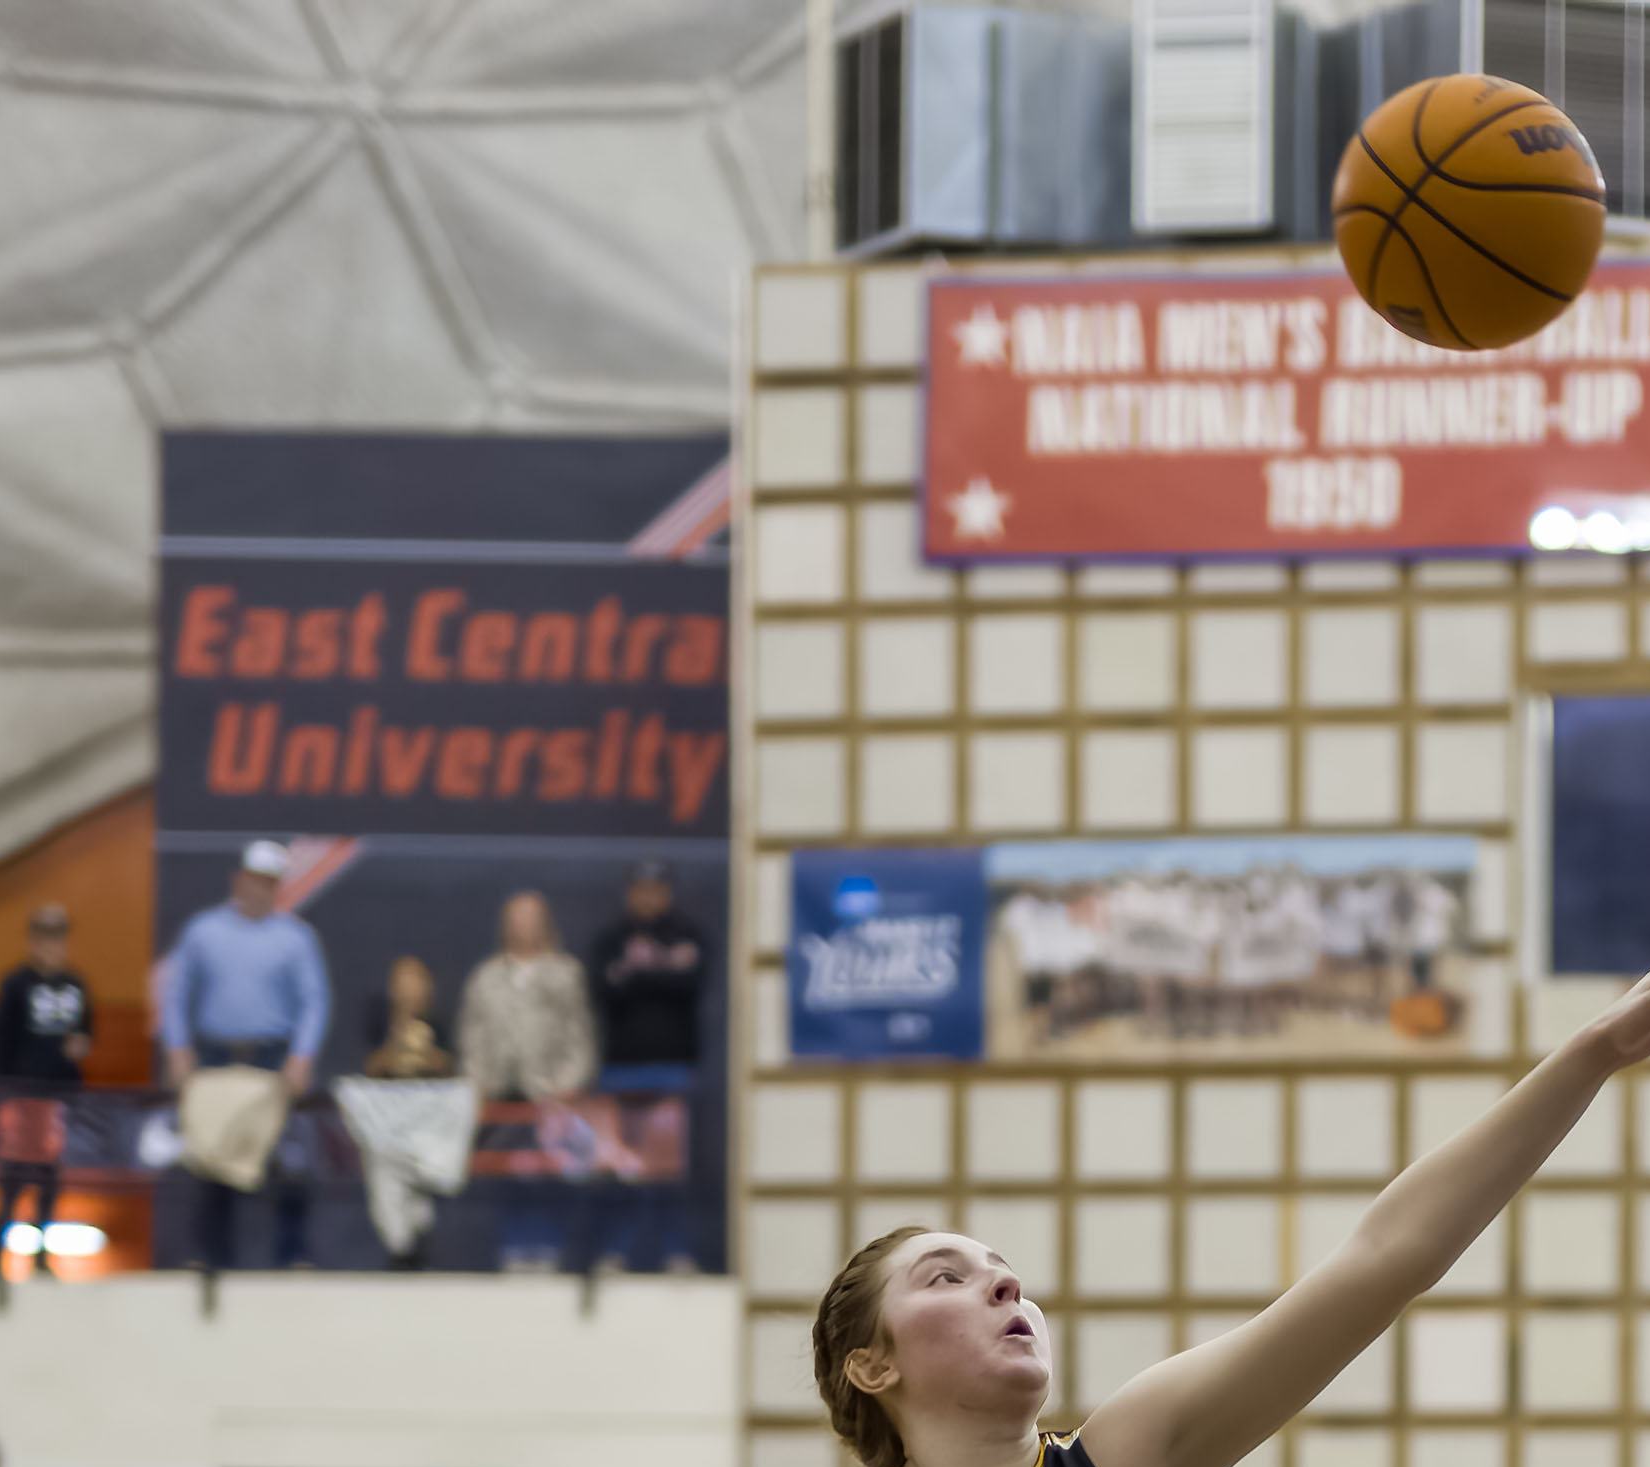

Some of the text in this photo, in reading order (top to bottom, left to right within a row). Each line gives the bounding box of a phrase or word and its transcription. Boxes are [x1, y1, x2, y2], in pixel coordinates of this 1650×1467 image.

[176, 587, 732, 685] East Centra
[208, 703, 726, 822] University
